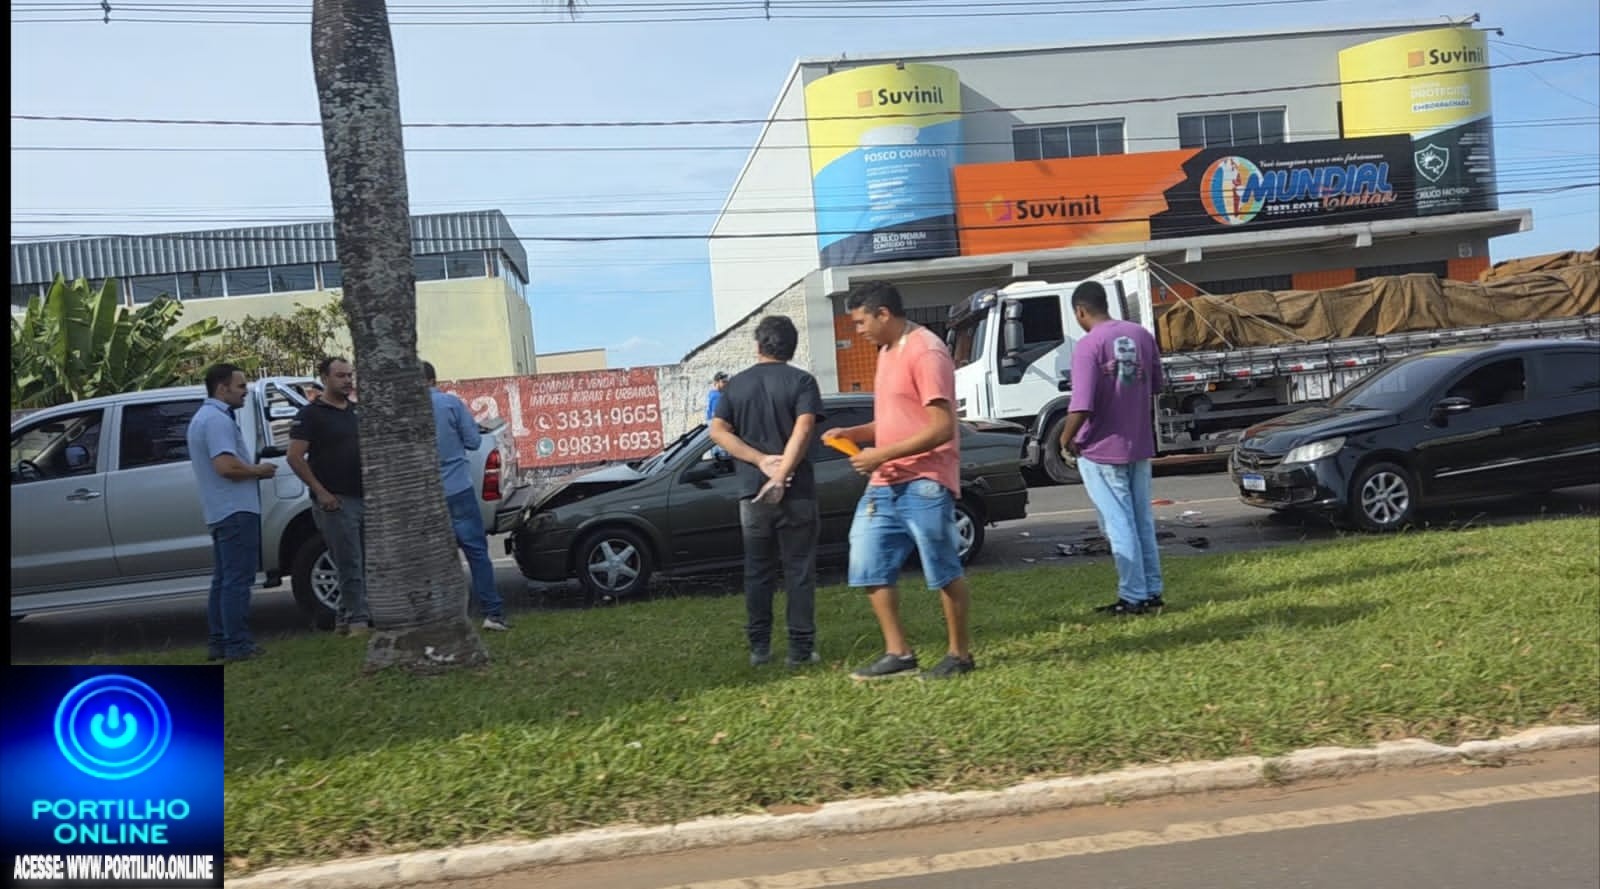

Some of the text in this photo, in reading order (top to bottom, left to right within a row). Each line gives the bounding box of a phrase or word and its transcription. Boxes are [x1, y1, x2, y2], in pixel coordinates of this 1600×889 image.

[1429, 47, 1484, 65] Suvinil
[878, 85, 943, 106] Suvinil
[864, 151, 897, 163] FOSCO
[1241, 162, 1392, 204] MUNDIAL
[1016, 194, 1101, 220] Suvinil
[577, 378, 584, 390] E
[605, 388, 613, 400] E
[614, 384, 657, 400] URBANOS
